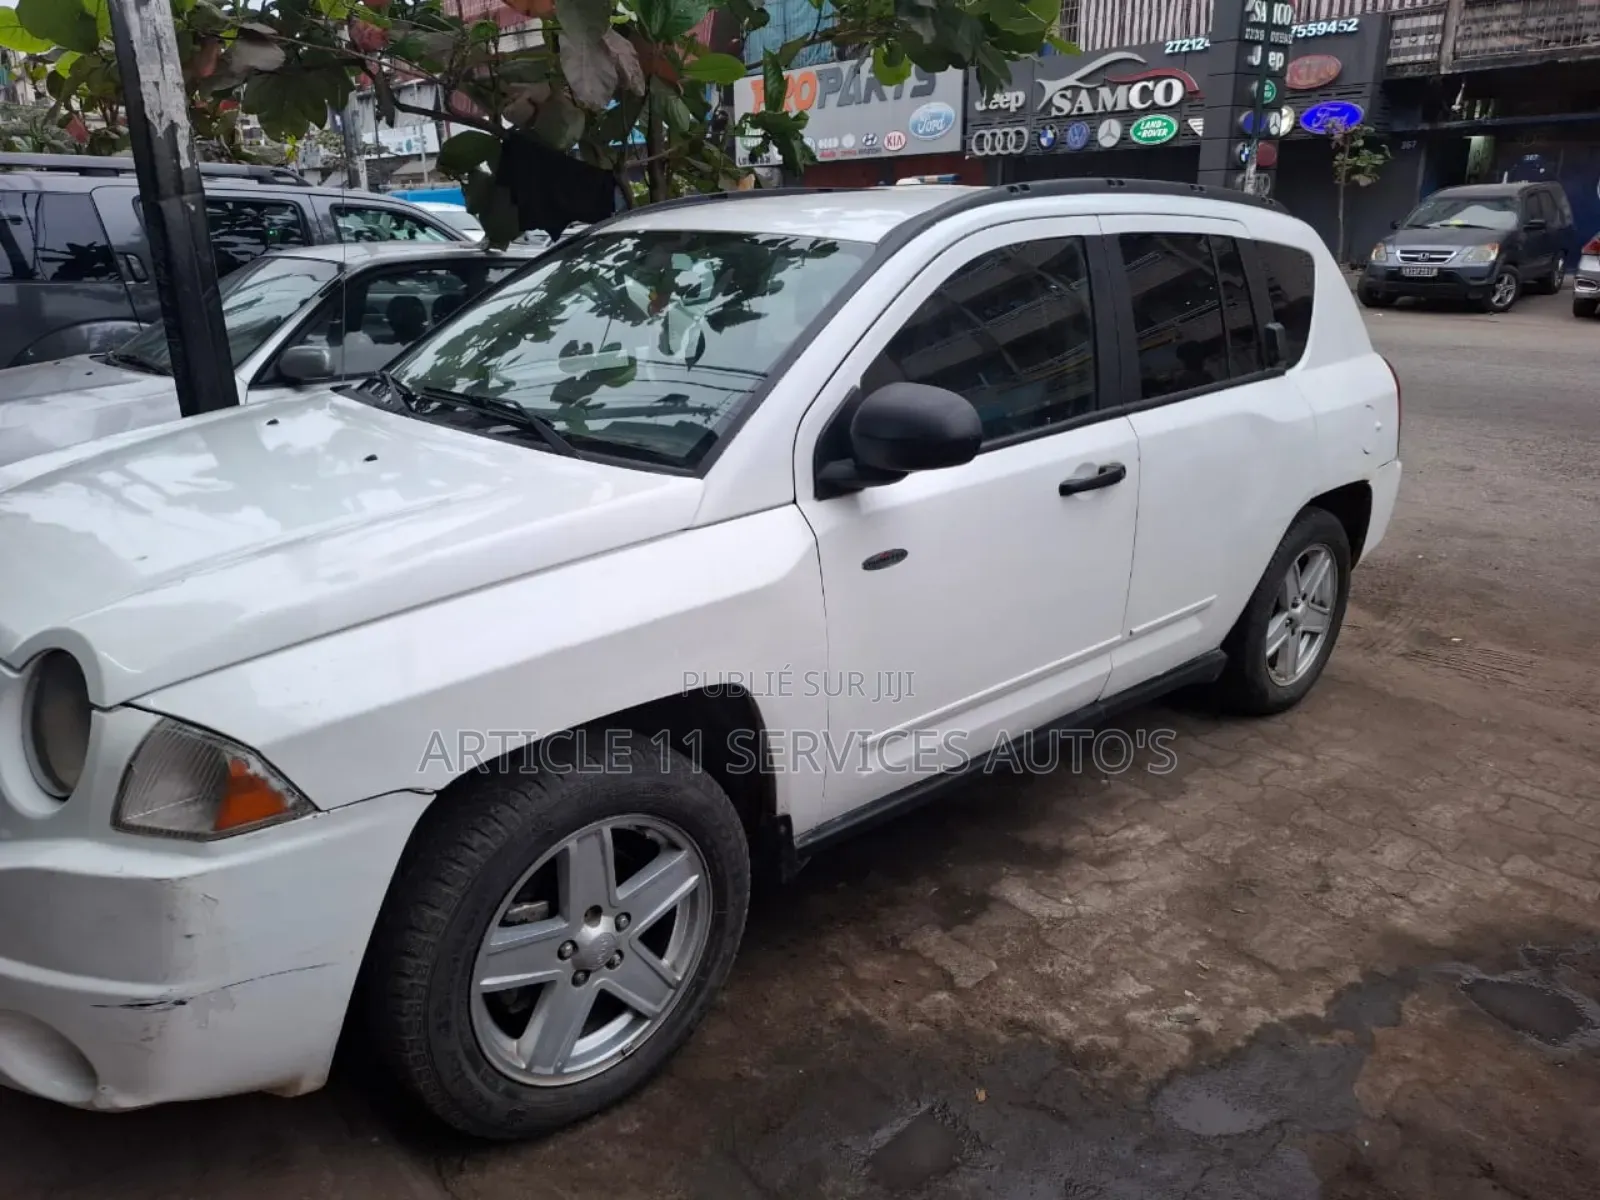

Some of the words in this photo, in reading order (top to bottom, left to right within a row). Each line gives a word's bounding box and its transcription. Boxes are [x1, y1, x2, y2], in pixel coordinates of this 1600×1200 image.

[1247, 45, 1284, 71] Jep
[1051, 78, 1184, 117] SAMCO
[917, 113, 946, 133] Ford
[887, 135, 903, 147] KIA
